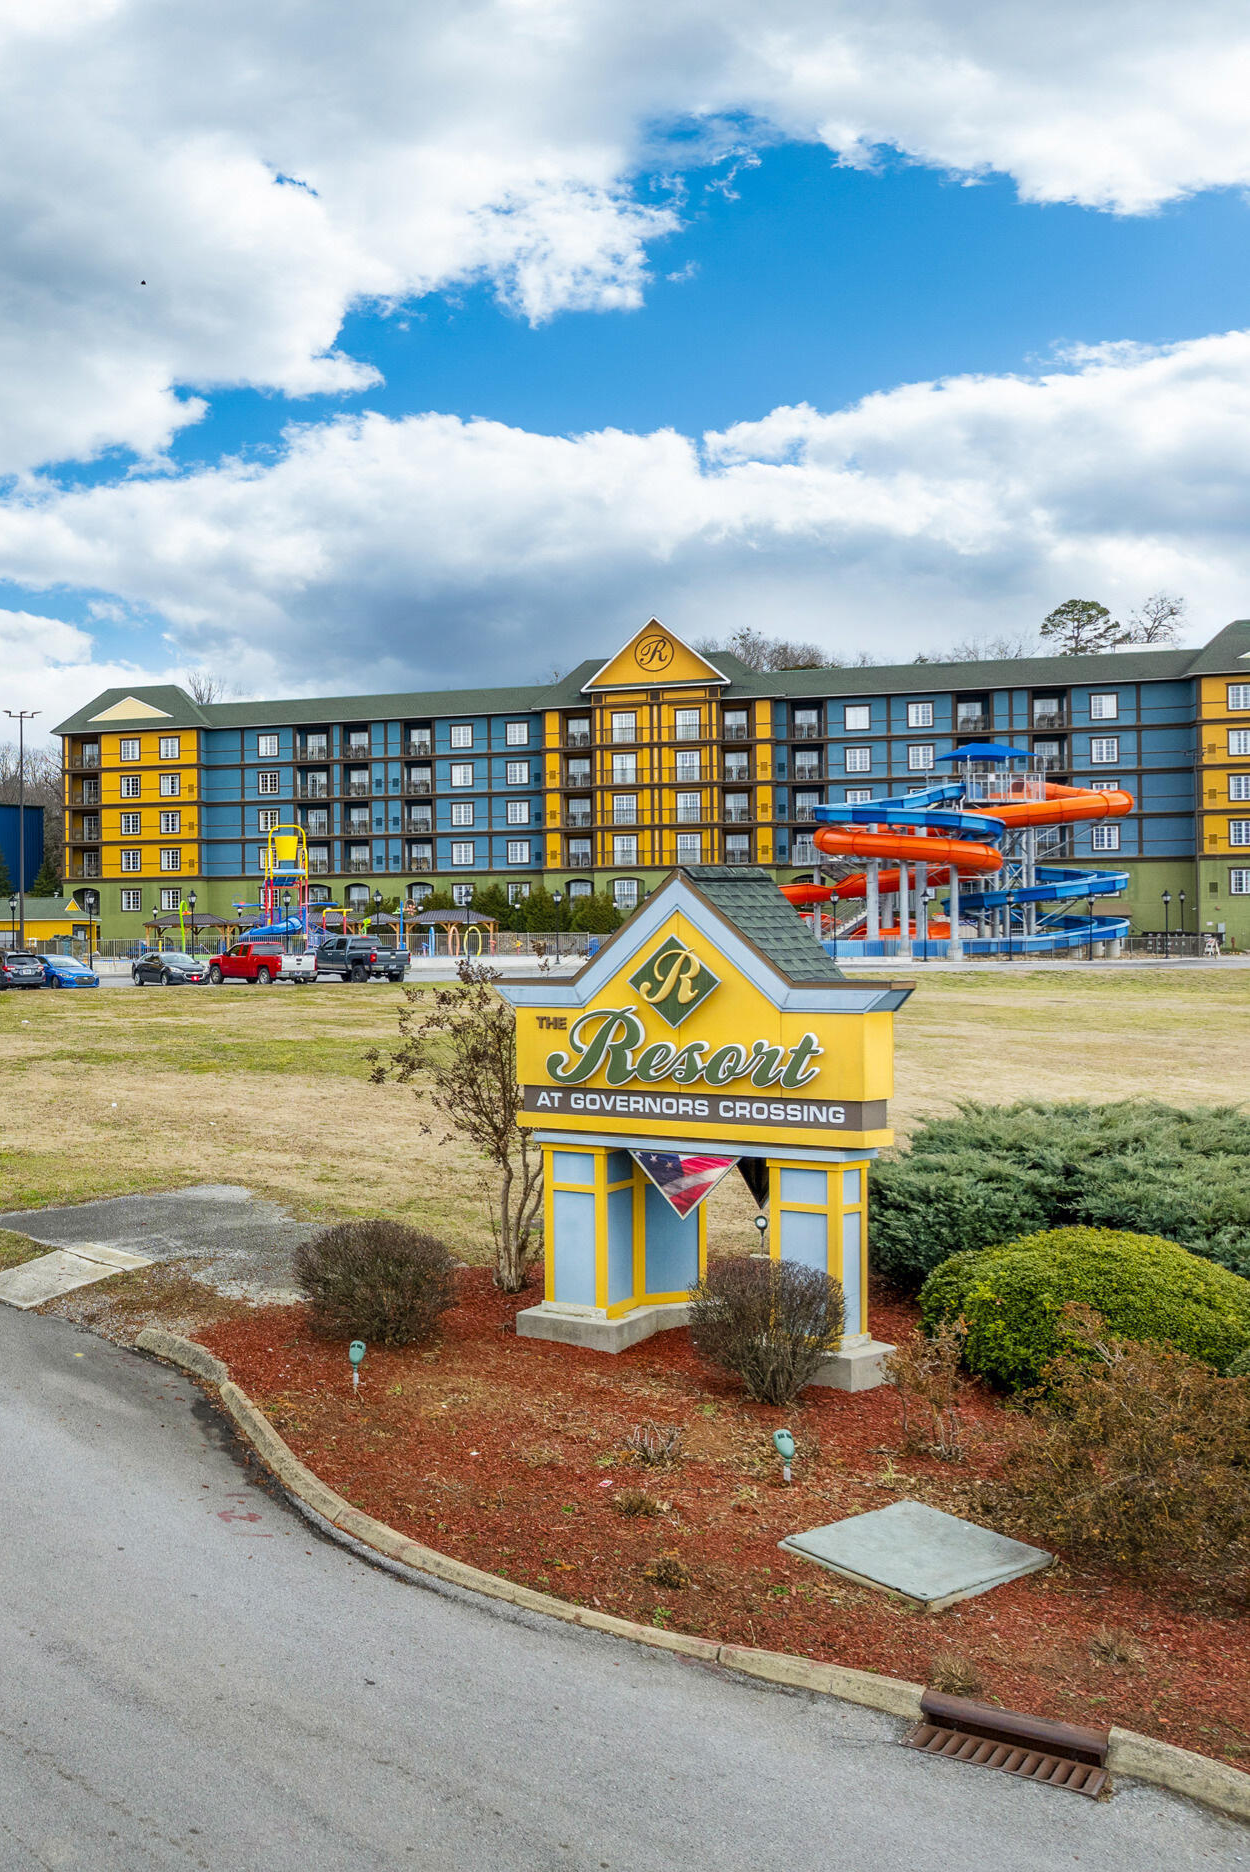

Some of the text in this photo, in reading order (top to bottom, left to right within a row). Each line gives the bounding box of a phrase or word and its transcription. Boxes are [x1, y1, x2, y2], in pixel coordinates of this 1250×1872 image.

[639, 638, 668, 665] R
[639, 947, 700, 1004] R
[536, 1005, 824, 1089] THE Resort
[536, 1091, 846, 1124] AT GOVERNORS CROSSING
